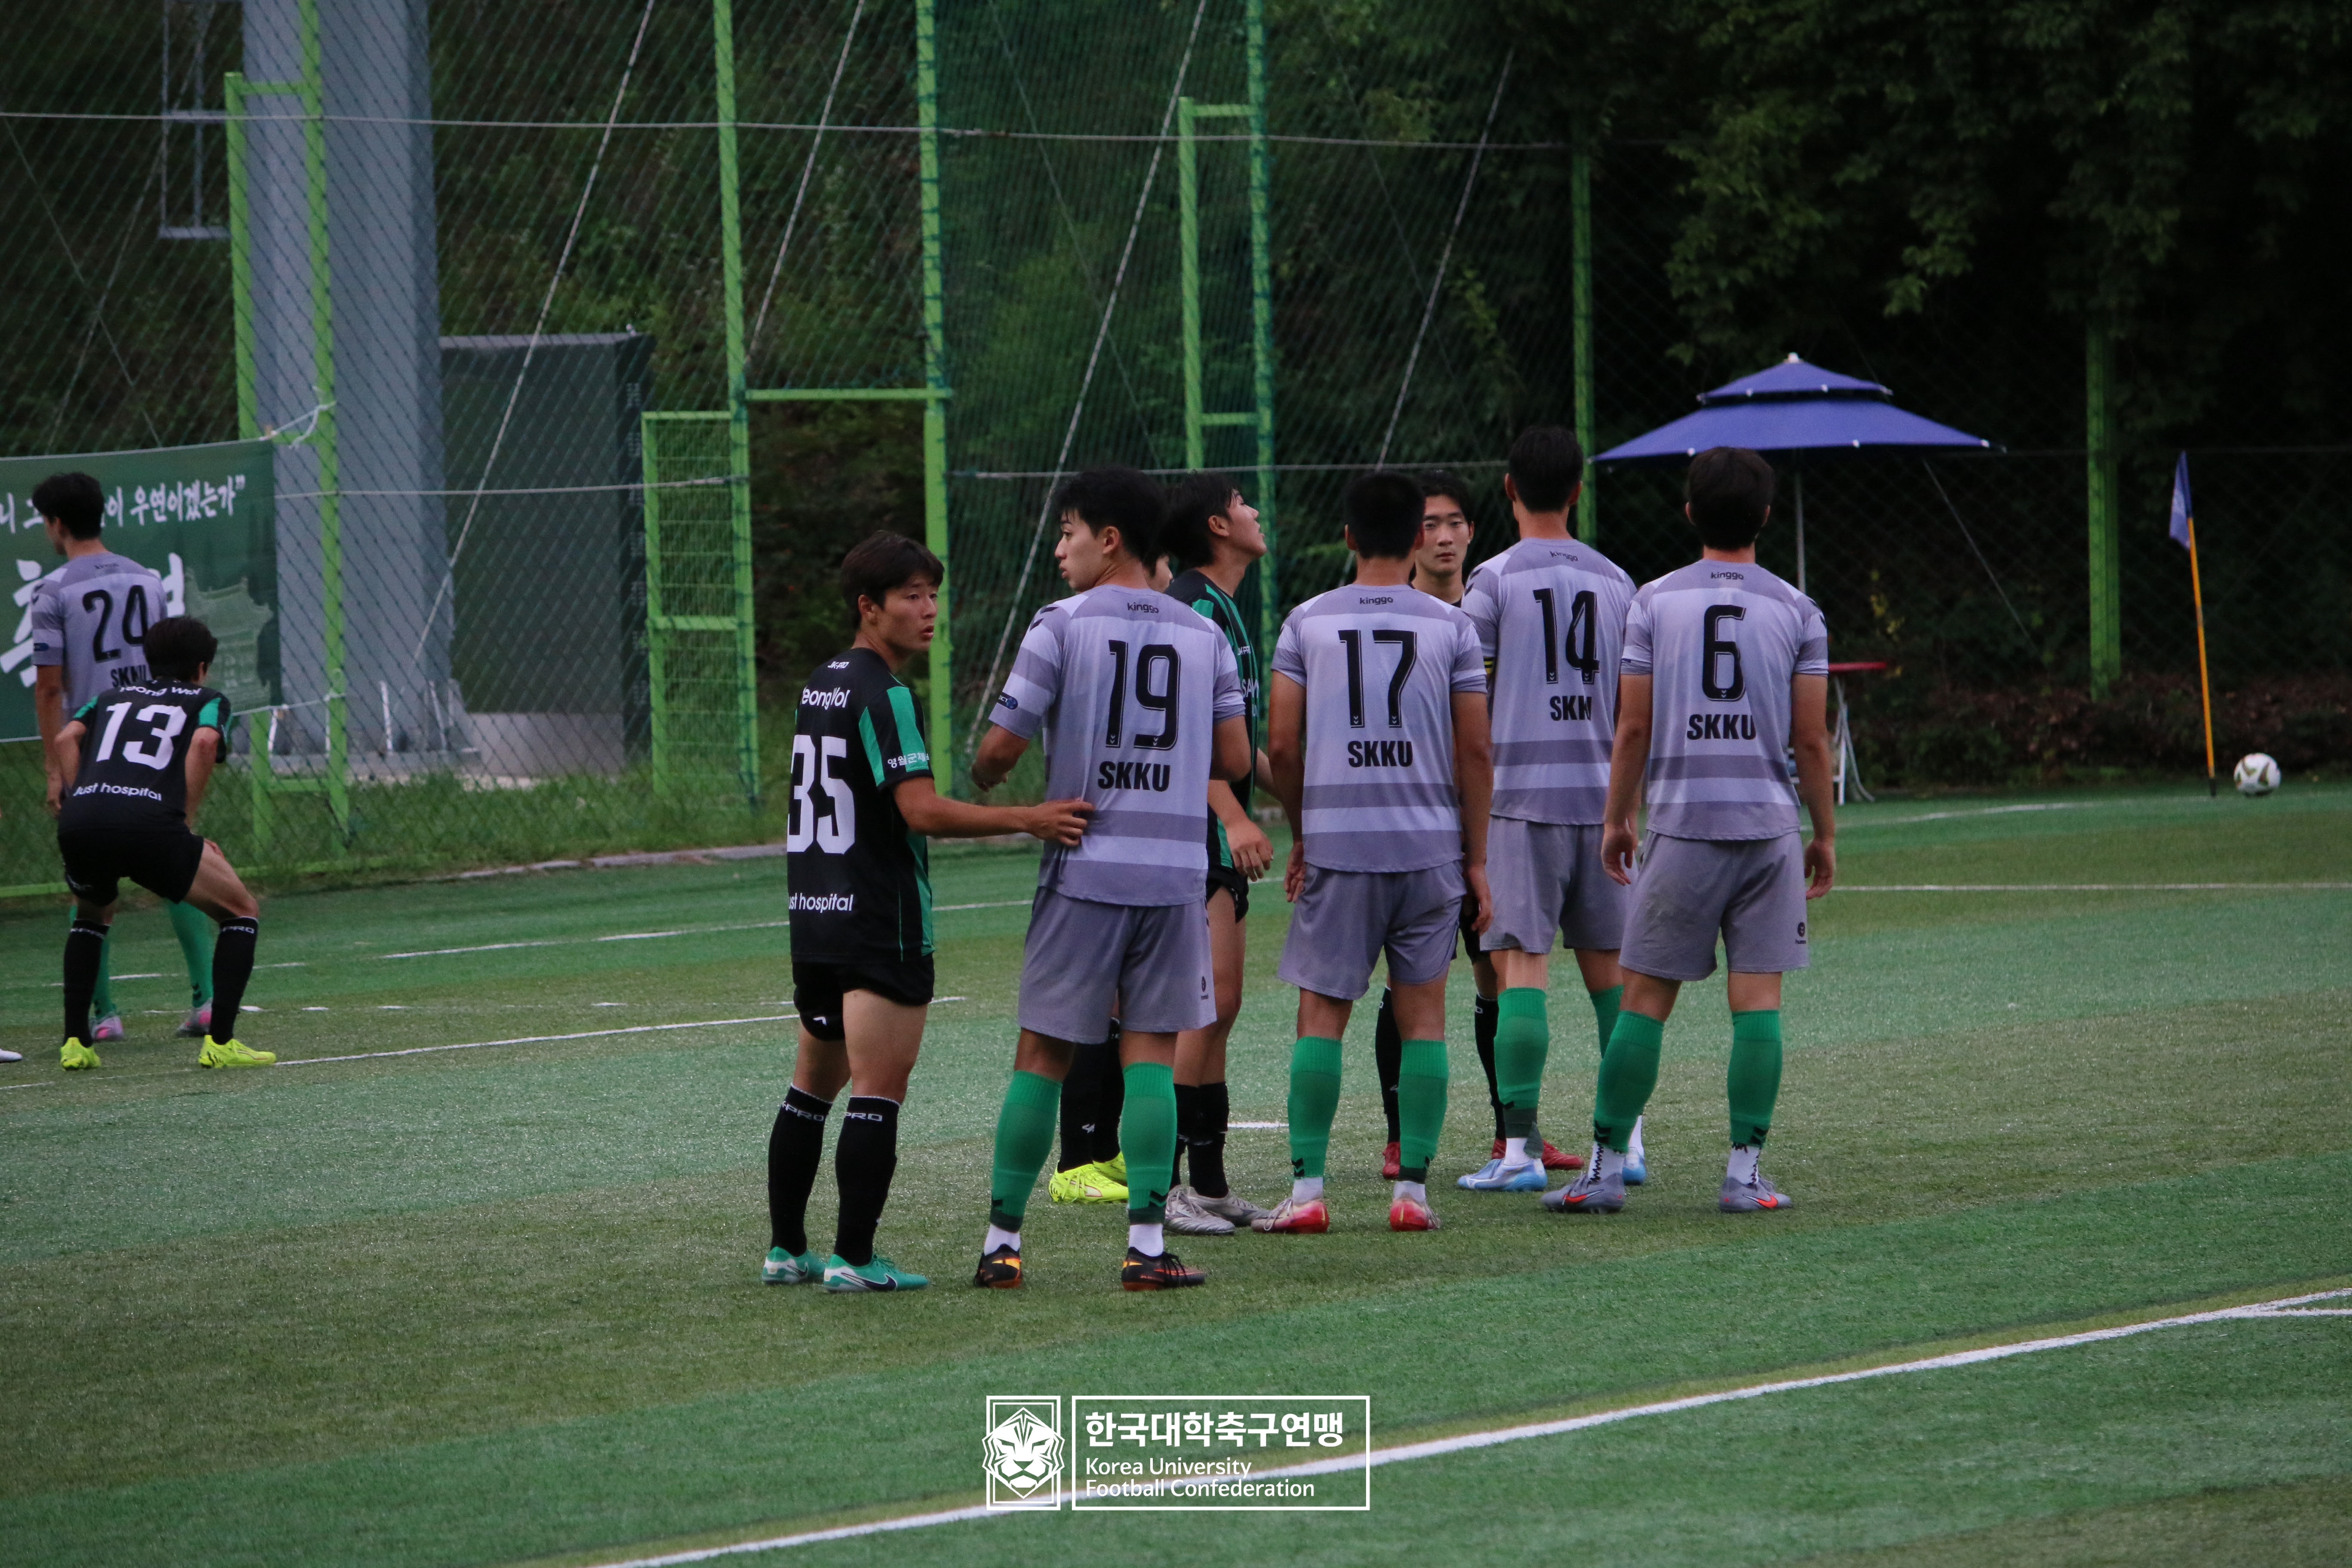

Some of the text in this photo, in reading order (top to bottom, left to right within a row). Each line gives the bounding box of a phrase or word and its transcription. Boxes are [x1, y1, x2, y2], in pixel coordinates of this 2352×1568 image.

[1711, 571, 1744, 581] kinggo
[1127, 602, 1159, 614] kinggo
[1359, 596, 1394, 606] kinggo
[1533, 588, 1600, 684] 14
[1702, 604, 1746, 701] 6
[1338, 629, 1417, 728] 17
[1106, 639, 1181, 751] 19
[96, 701, 187, 770] 13
[1687, 714, 1757, 740] SKKU
[1348, 740, 1413, 768] SKKU
[1097, 760, 1170, 792] SKKU
[100, 782, 162, 801] hospital
[787, 734, 855, 854] 35
[799, 892, 854, 913] hospital
